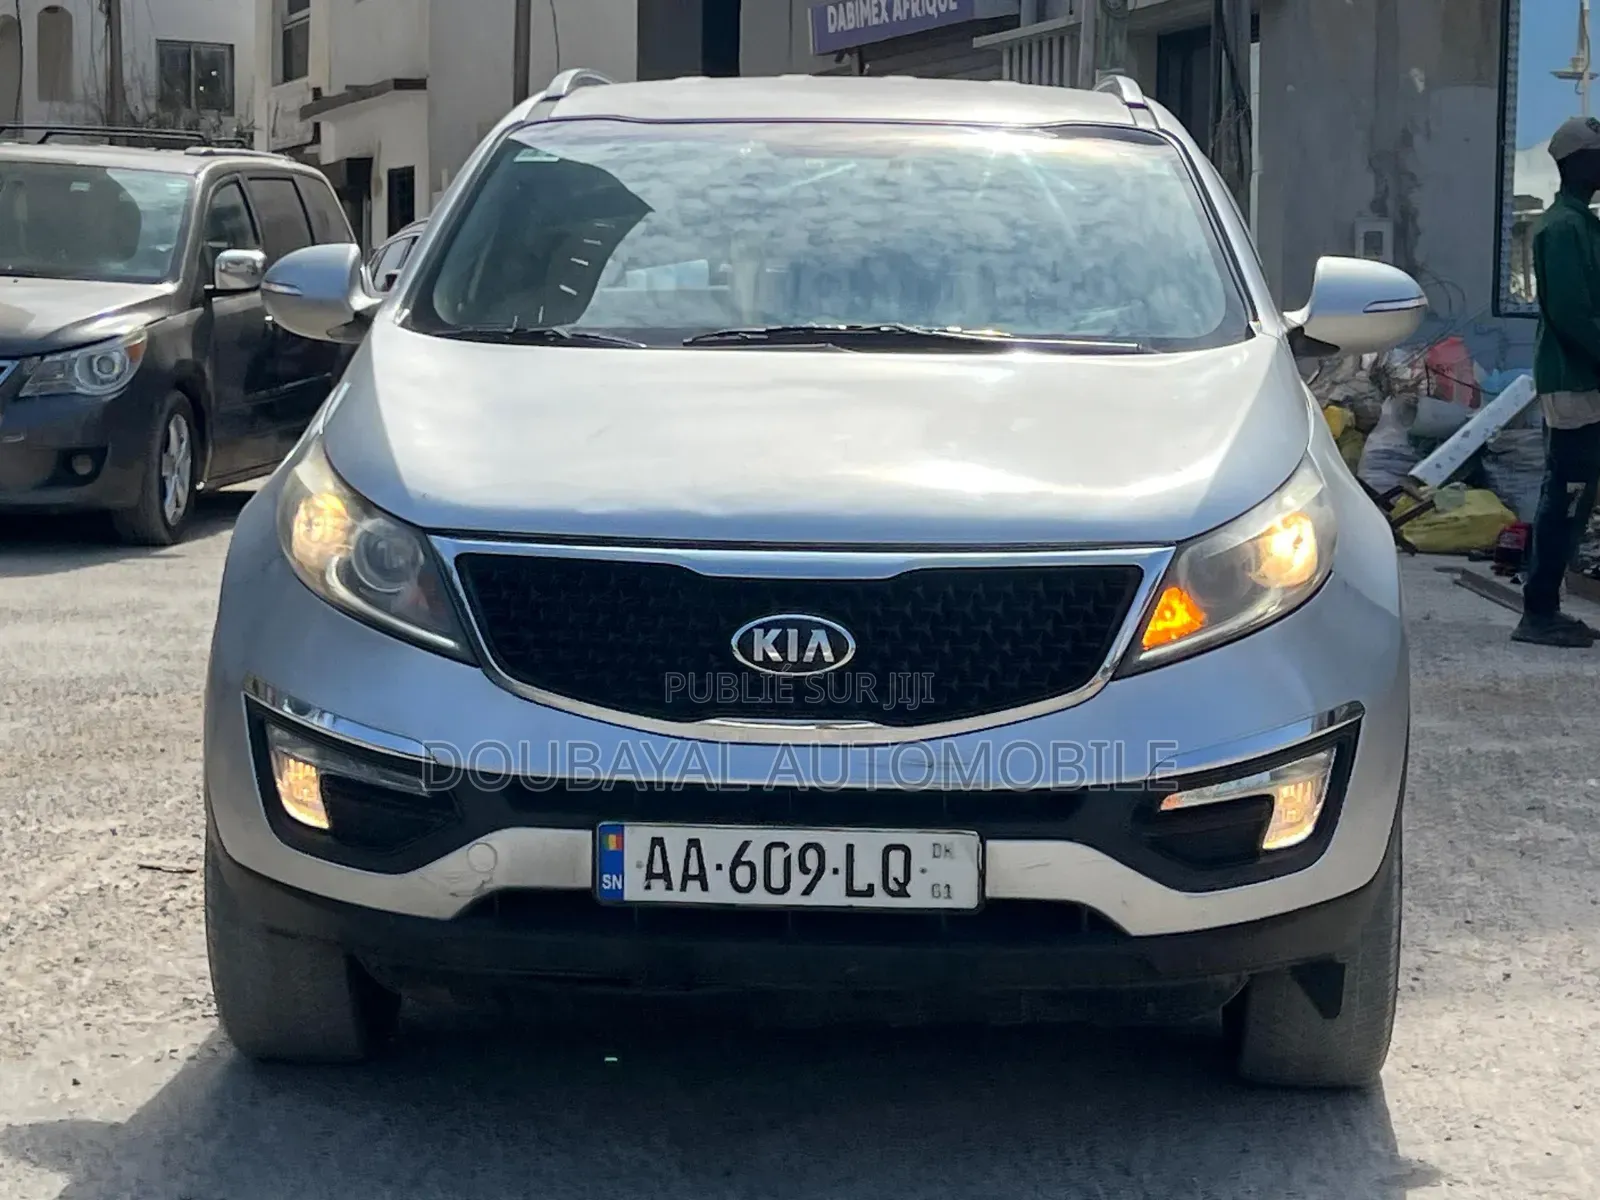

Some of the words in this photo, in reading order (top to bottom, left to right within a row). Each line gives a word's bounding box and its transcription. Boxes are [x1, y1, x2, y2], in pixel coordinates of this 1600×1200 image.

[827, 0, 889, 33] DABIMEX
[753, 628, 834, 662] KIA
[602, 874, 622, 890] SN
